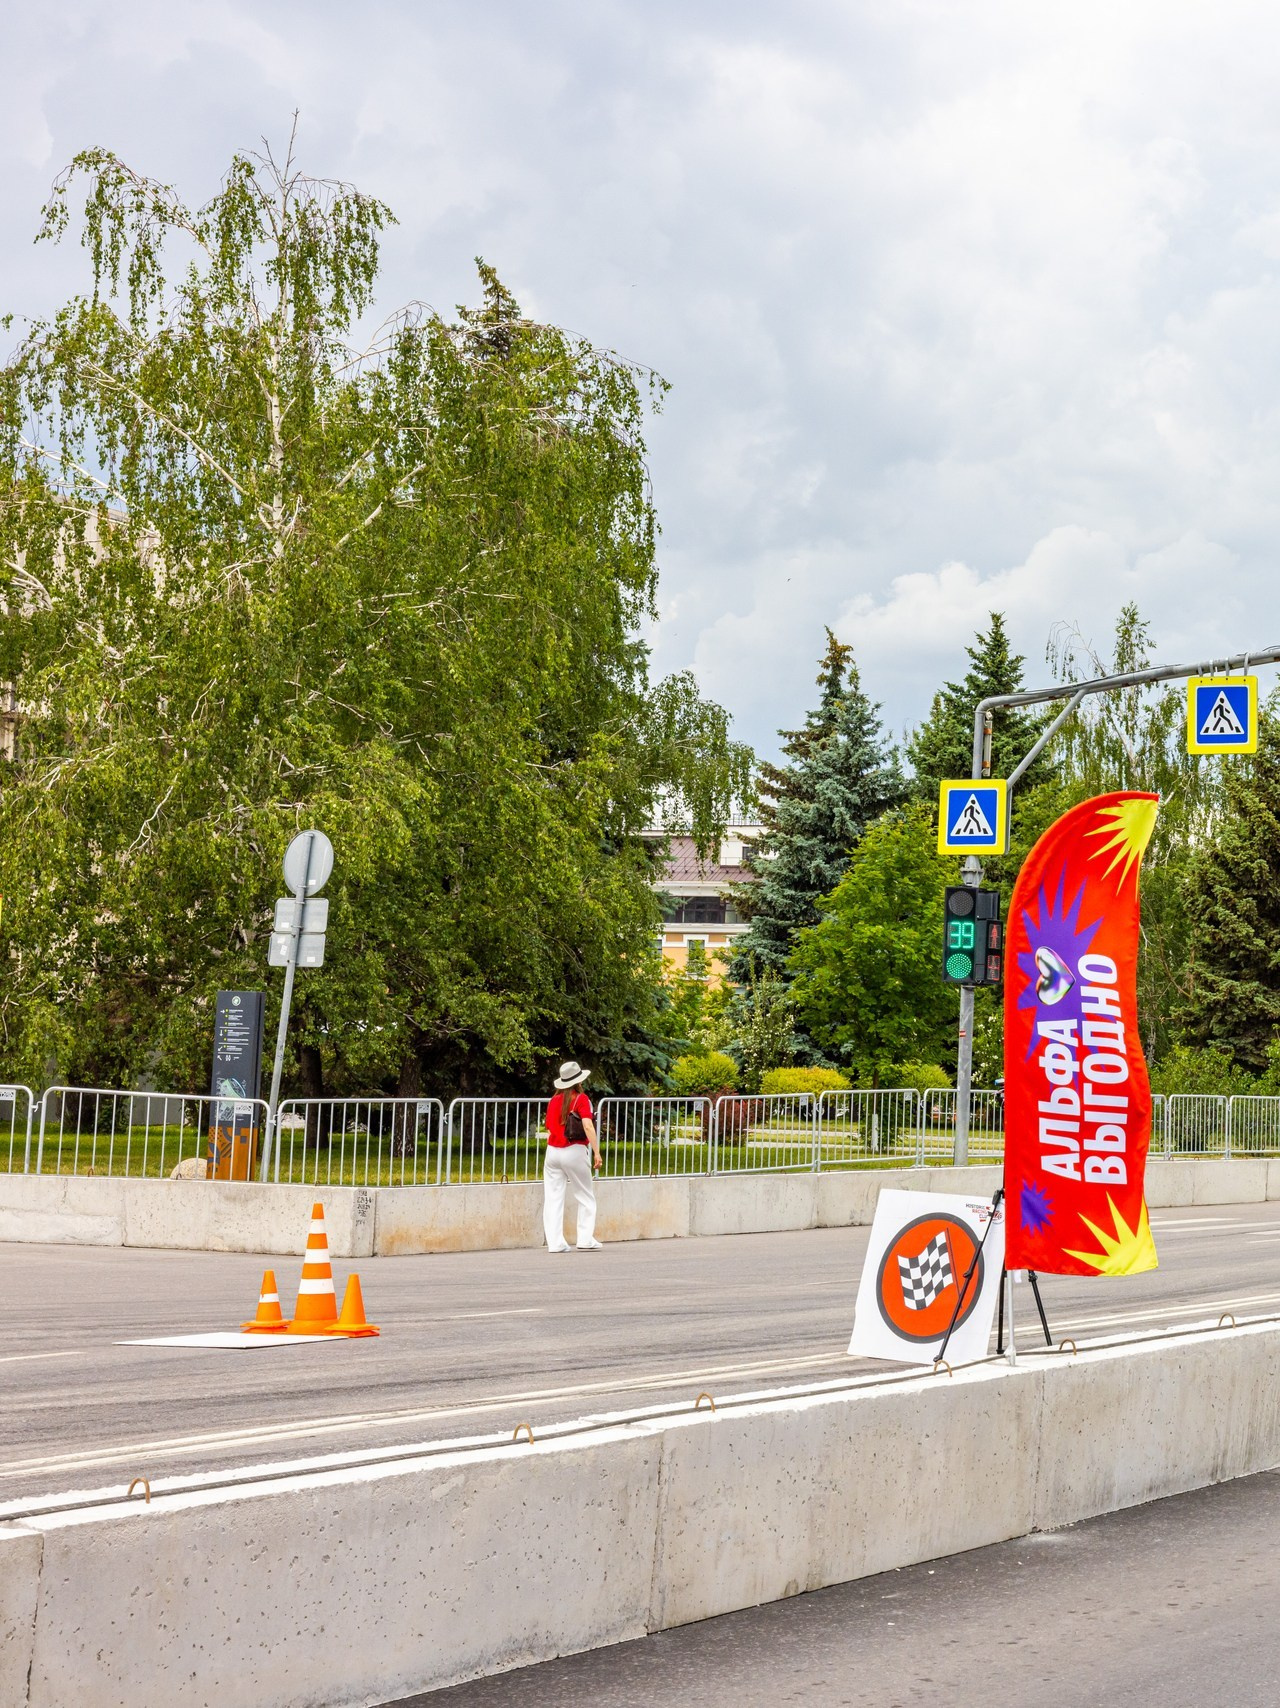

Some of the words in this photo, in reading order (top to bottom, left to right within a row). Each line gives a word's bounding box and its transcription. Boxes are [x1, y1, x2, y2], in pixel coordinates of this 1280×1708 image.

[949, 921, 974, 949] 39
[1037, 1018, 1082, 1182] АЛЬФА
[1077, 953, 1130, 1185] ВЫГОДНО
